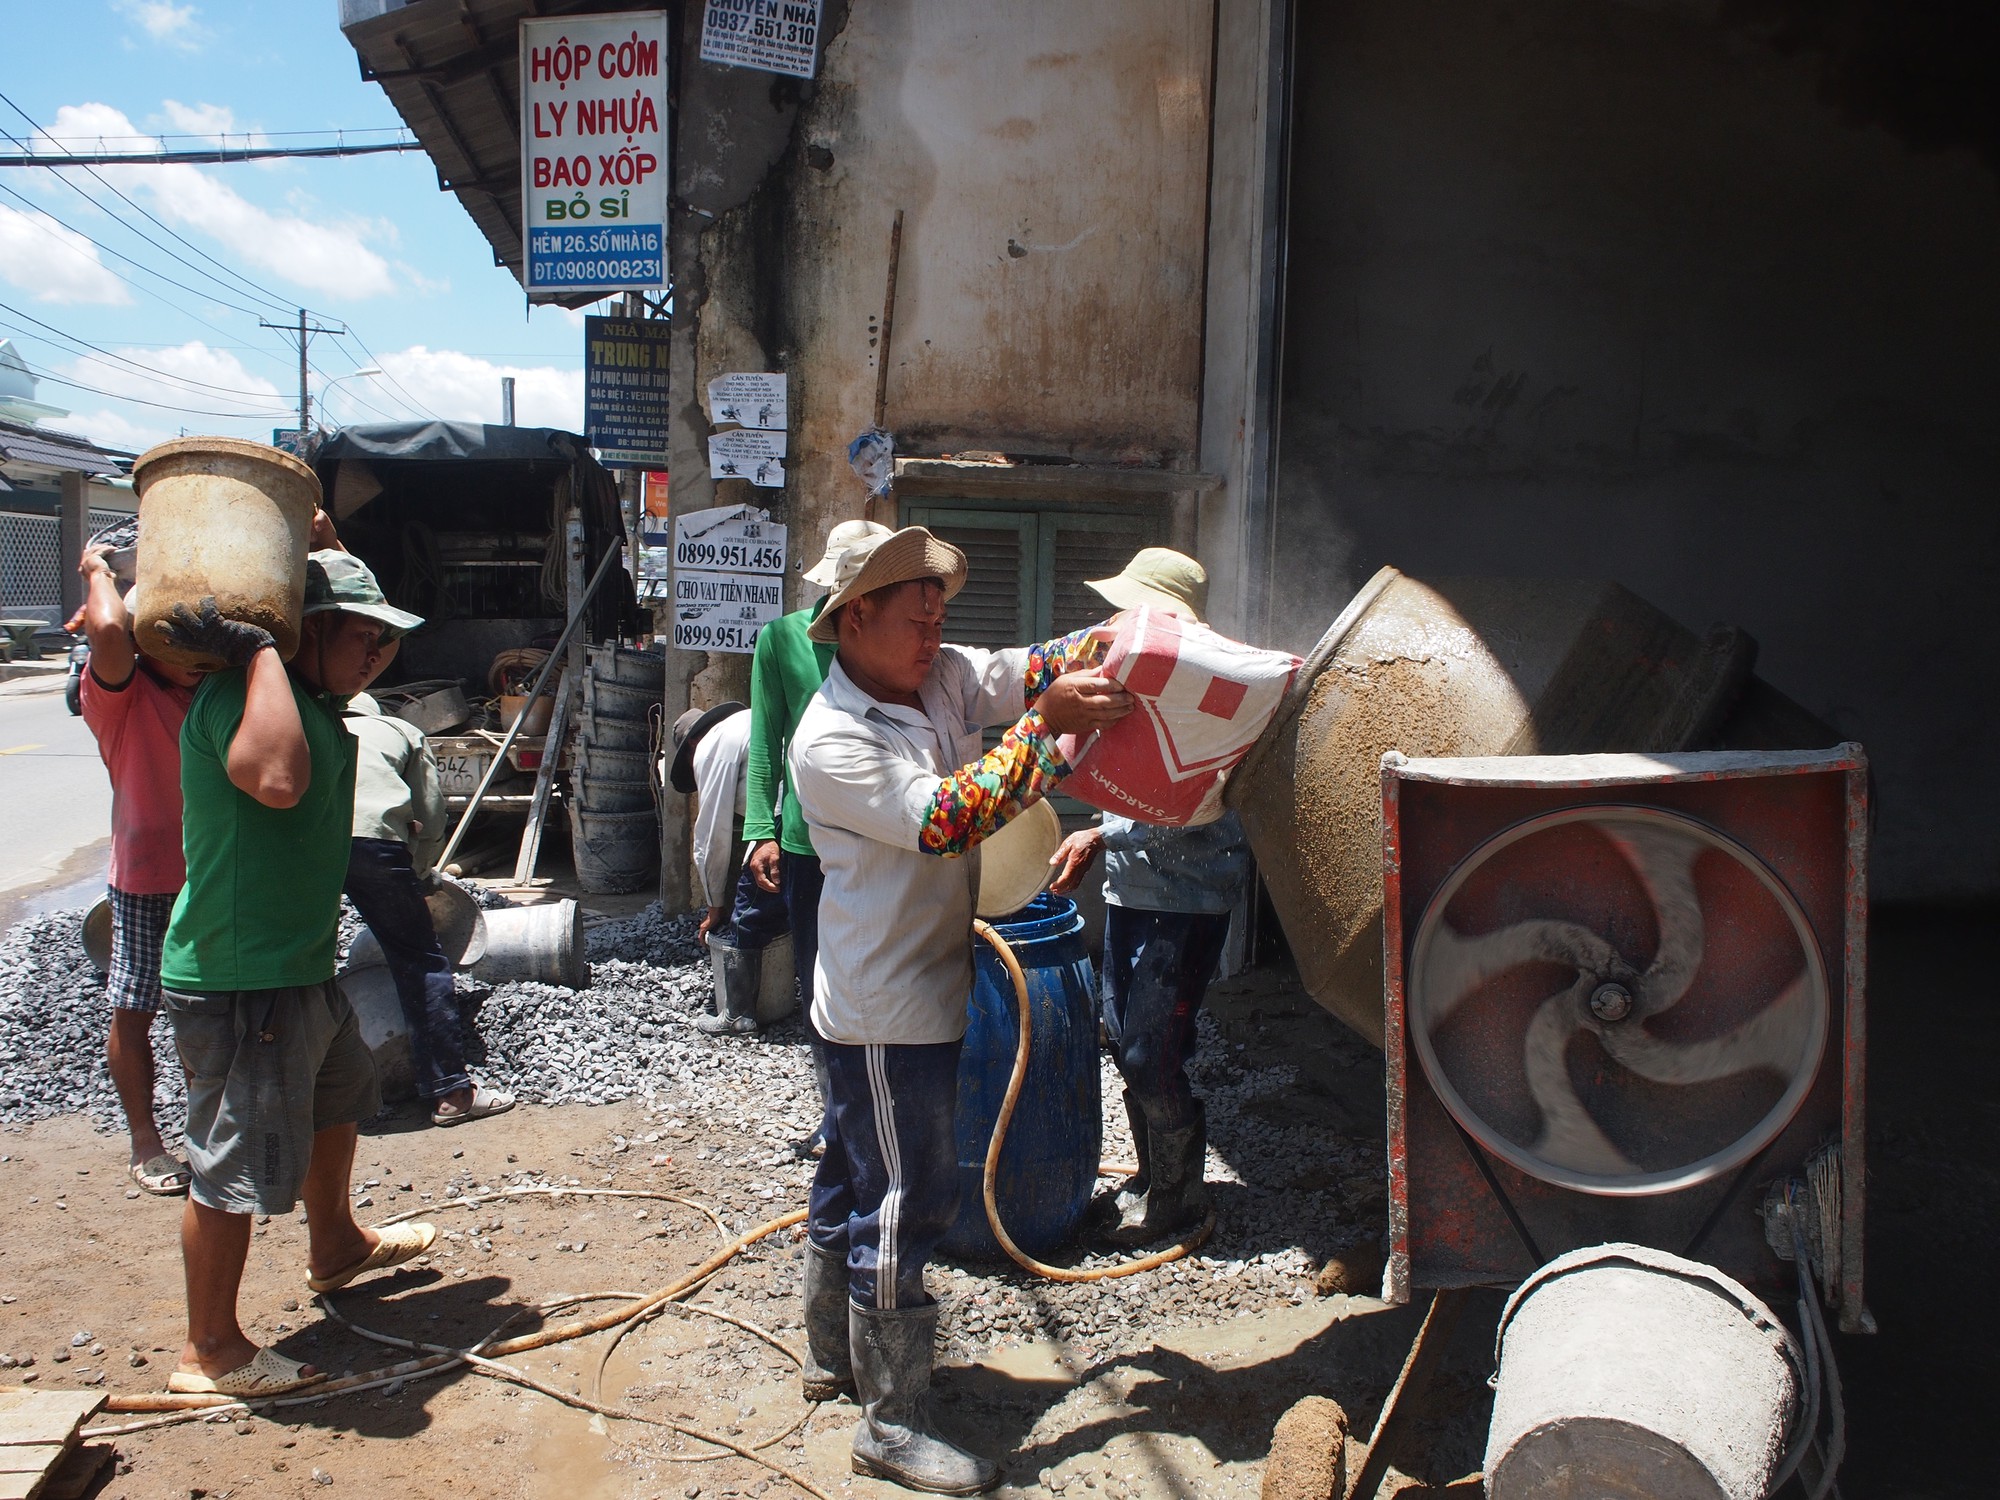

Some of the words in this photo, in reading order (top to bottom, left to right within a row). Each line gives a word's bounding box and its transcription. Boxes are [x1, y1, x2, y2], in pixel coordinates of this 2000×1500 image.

[708, 9, 814, 46] 0937.551.310
[783, 4, 816, 26] NHÀ
[532, 36, 591, 90] HỘP
[598, 31, 657, 79] CƠM
[534, 101, 568, 137] LY
[578, 89, 658, 143] NHỰA
[534, 155, 591, 188] BAO
[599, 146, 657, 186] XỐP
[546, 191, 590, 220] BỎ
[599, 189, 629, 218] SỈ
[533, 231, 561, 253] HẺM
[535, 260, 661, 281] ĐT:0908008231
[603, 323, 639, 337] NHÀ
[591, 340, 650, 368] TRUNG
[656, 344, 670, 369] N
[602, 371, 621, 387] PHỤC
[622, 372, 639, 386] NAM
[607, 389, 624, 401] BIỆT
[631, 391, 659, 401] VESTON
[646, 417, 660, 425] CAO
[678, 542, 782, 569] 0899.951.456
[677, 580, 698, 599] CHO
[700, 582, 718, 601] VAY
[720, 578, 743, 602] TIỀN
[744, 585, 779, 605] NHANH
[436, 756, 469, 773] 54Z
[1090, 769, 1166, 817] STARCEMT
